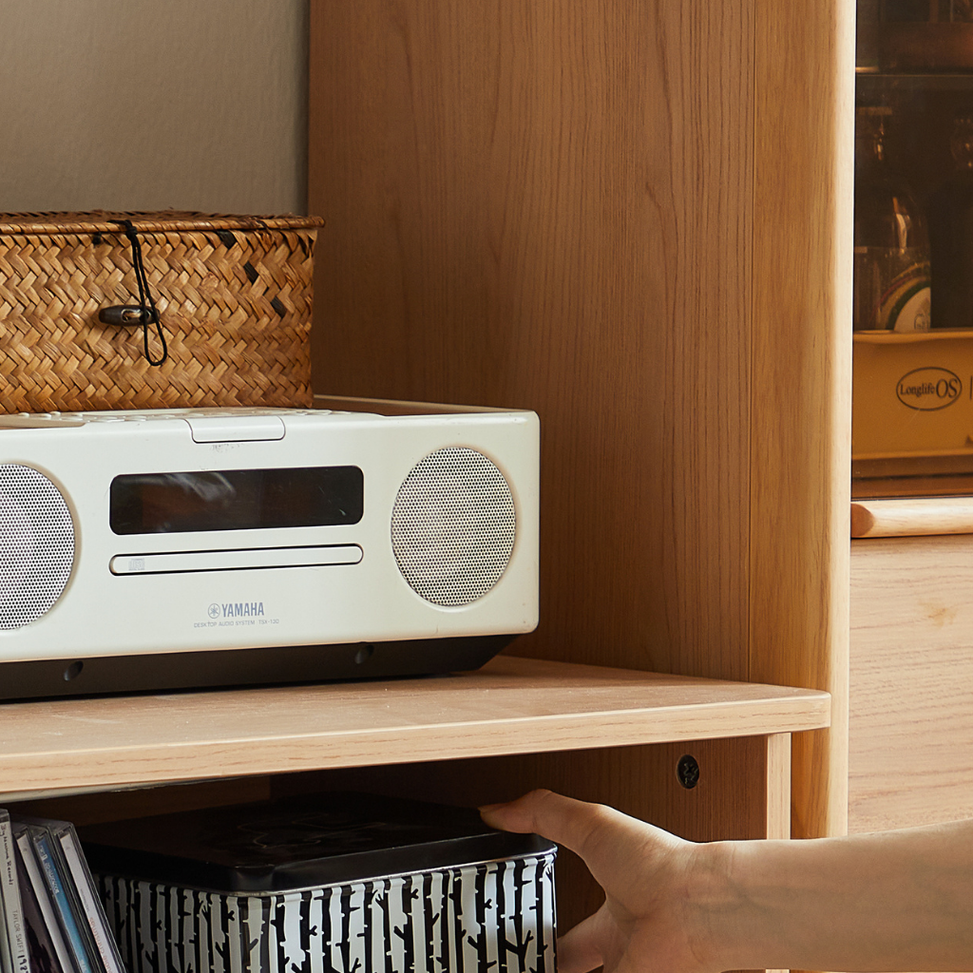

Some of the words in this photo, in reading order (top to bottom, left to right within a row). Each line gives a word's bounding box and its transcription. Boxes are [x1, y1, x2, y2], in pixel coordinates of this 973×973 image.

[221, 602, 265, 618] YAMAHA
[12, 910, 21, 933] TAYLOR
[15, 933, 25, 954] SWIFT
